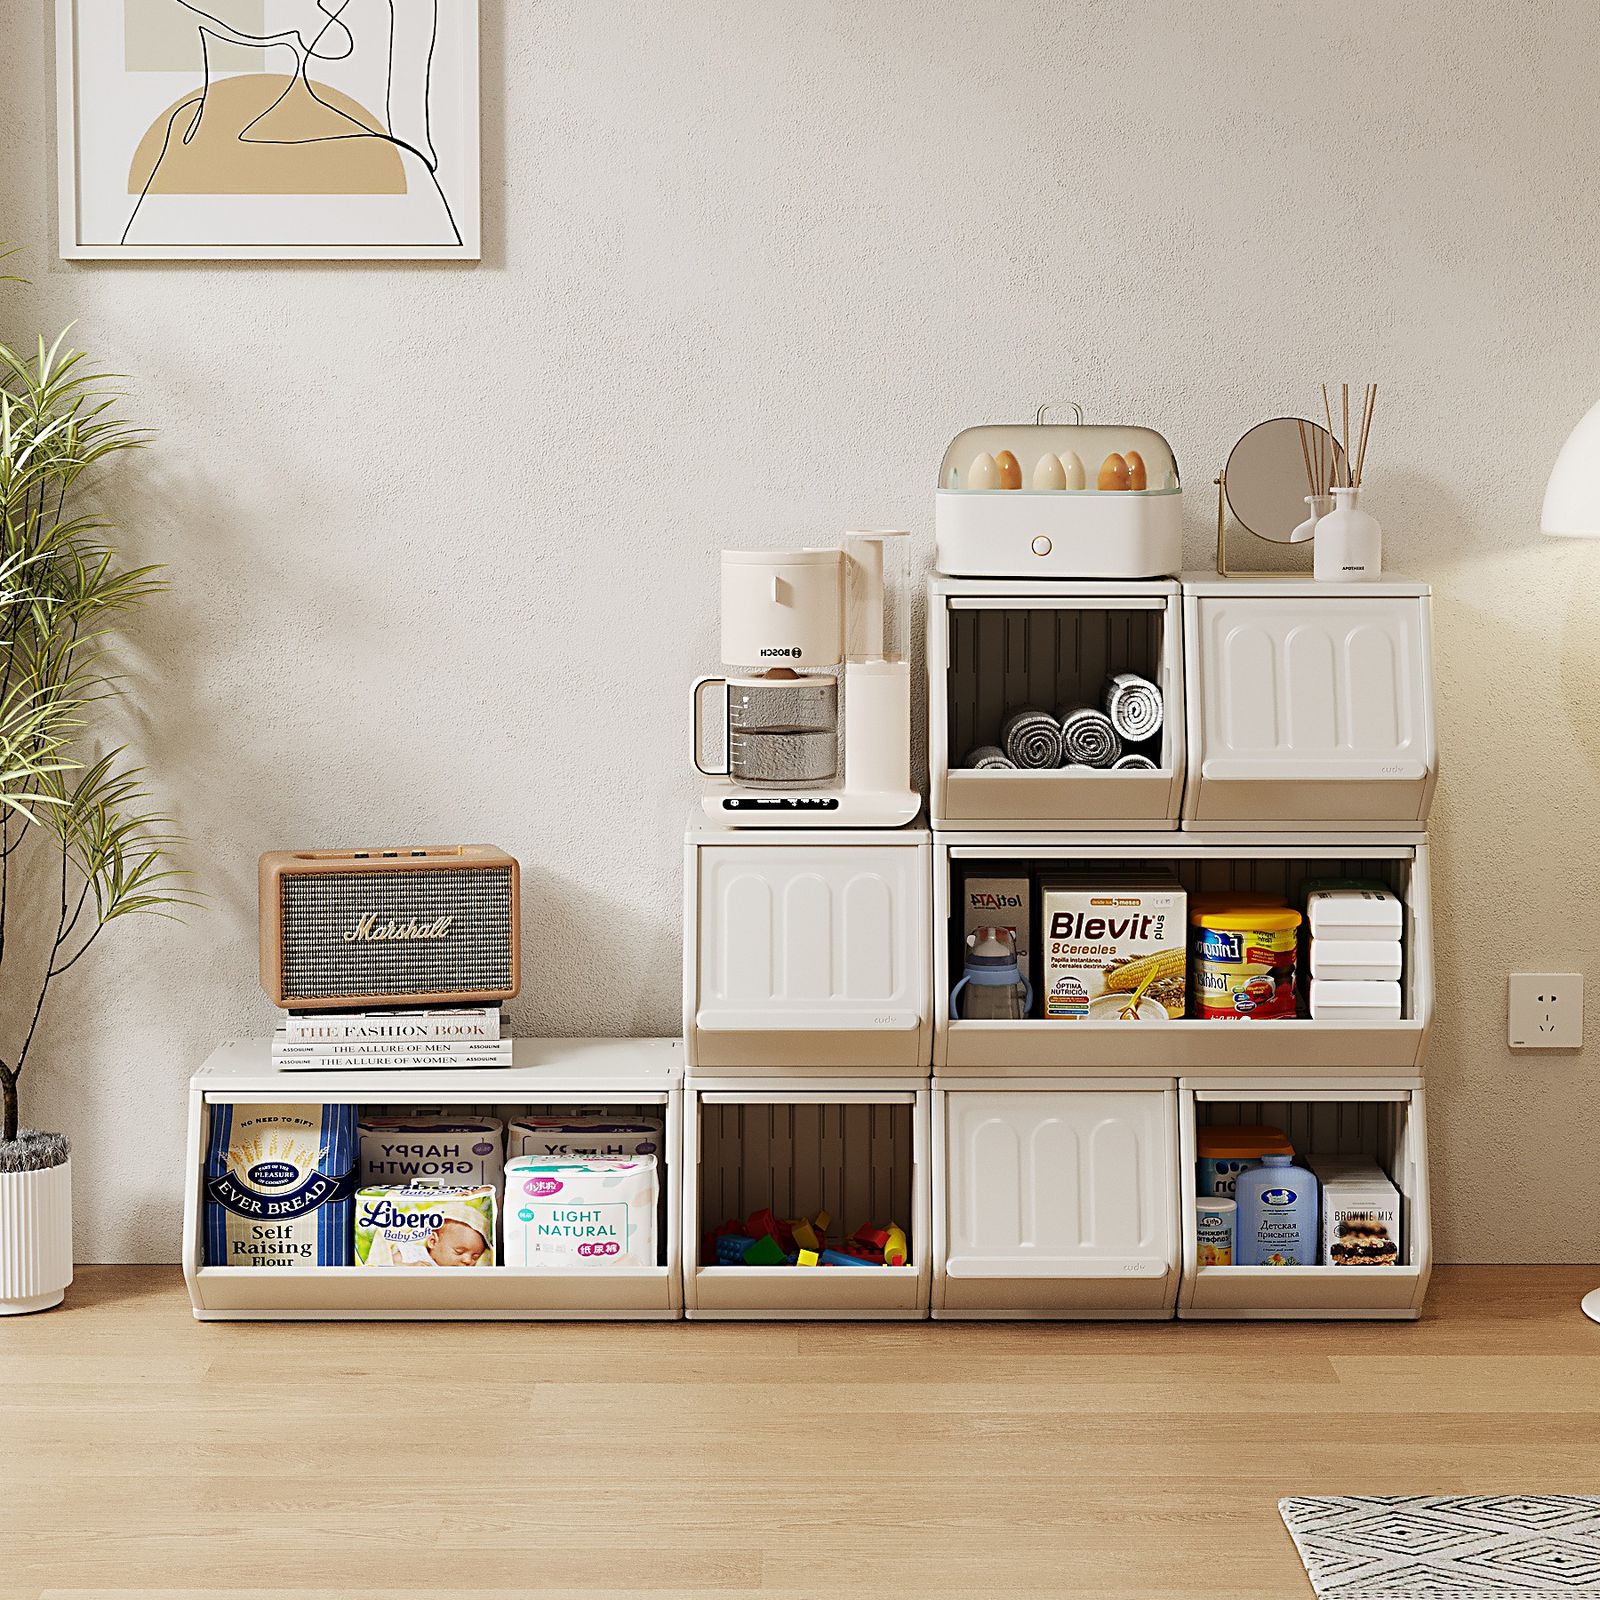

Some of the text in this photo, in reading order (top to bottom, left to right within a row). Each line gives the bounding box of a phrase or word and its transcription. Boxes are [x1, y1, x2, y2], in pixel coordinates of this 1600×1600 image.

[1112, 898, 1120, 908] 5
[343, 912, 453, 941] Marshall
[1049, 912, 1151, 940] Blevit
[1154, 914, 1166, 940] plus
[1051, 942, 1117, 955] 8 Cereales
[296, 1024, 485, 1038] THE FASHION BOOK
[357, 1044, 404, 1053] ALLURE
[406, 1044, 422, 1052] OF
[425, 1043, 451, 1052] MEN
[319, 1058, 342, 1066] THE
[344, 1057, 391, 1066] ALLURE
[393, 1056, 409, 1065] OF
[412, 1055, 458, 1065] WOMEN
[240, 1119, 253, 1128] NO
[255, 1116, 279, 1125] NEED
[217, 1180, 327, 1215] EVER BREAD
[359, 1200, 443, 1228] Libero
[552, 1210, 602, 1222] LIGHT
[1334, 1211, 1393, 1221] BROWNIE MIX
[252, 1225, 293, 1239] Self
[538, 1224, 617, 1237] NATURAL
[1260, 1220, 1297, 1231] Детская
[383, 1227, 433, 1241] Baby Soft
[1257, 1231, 1300, 1240] присыпка
[232, 1240, 313, 1258] Raising
[252, 1256, 294, 1267] Flour
